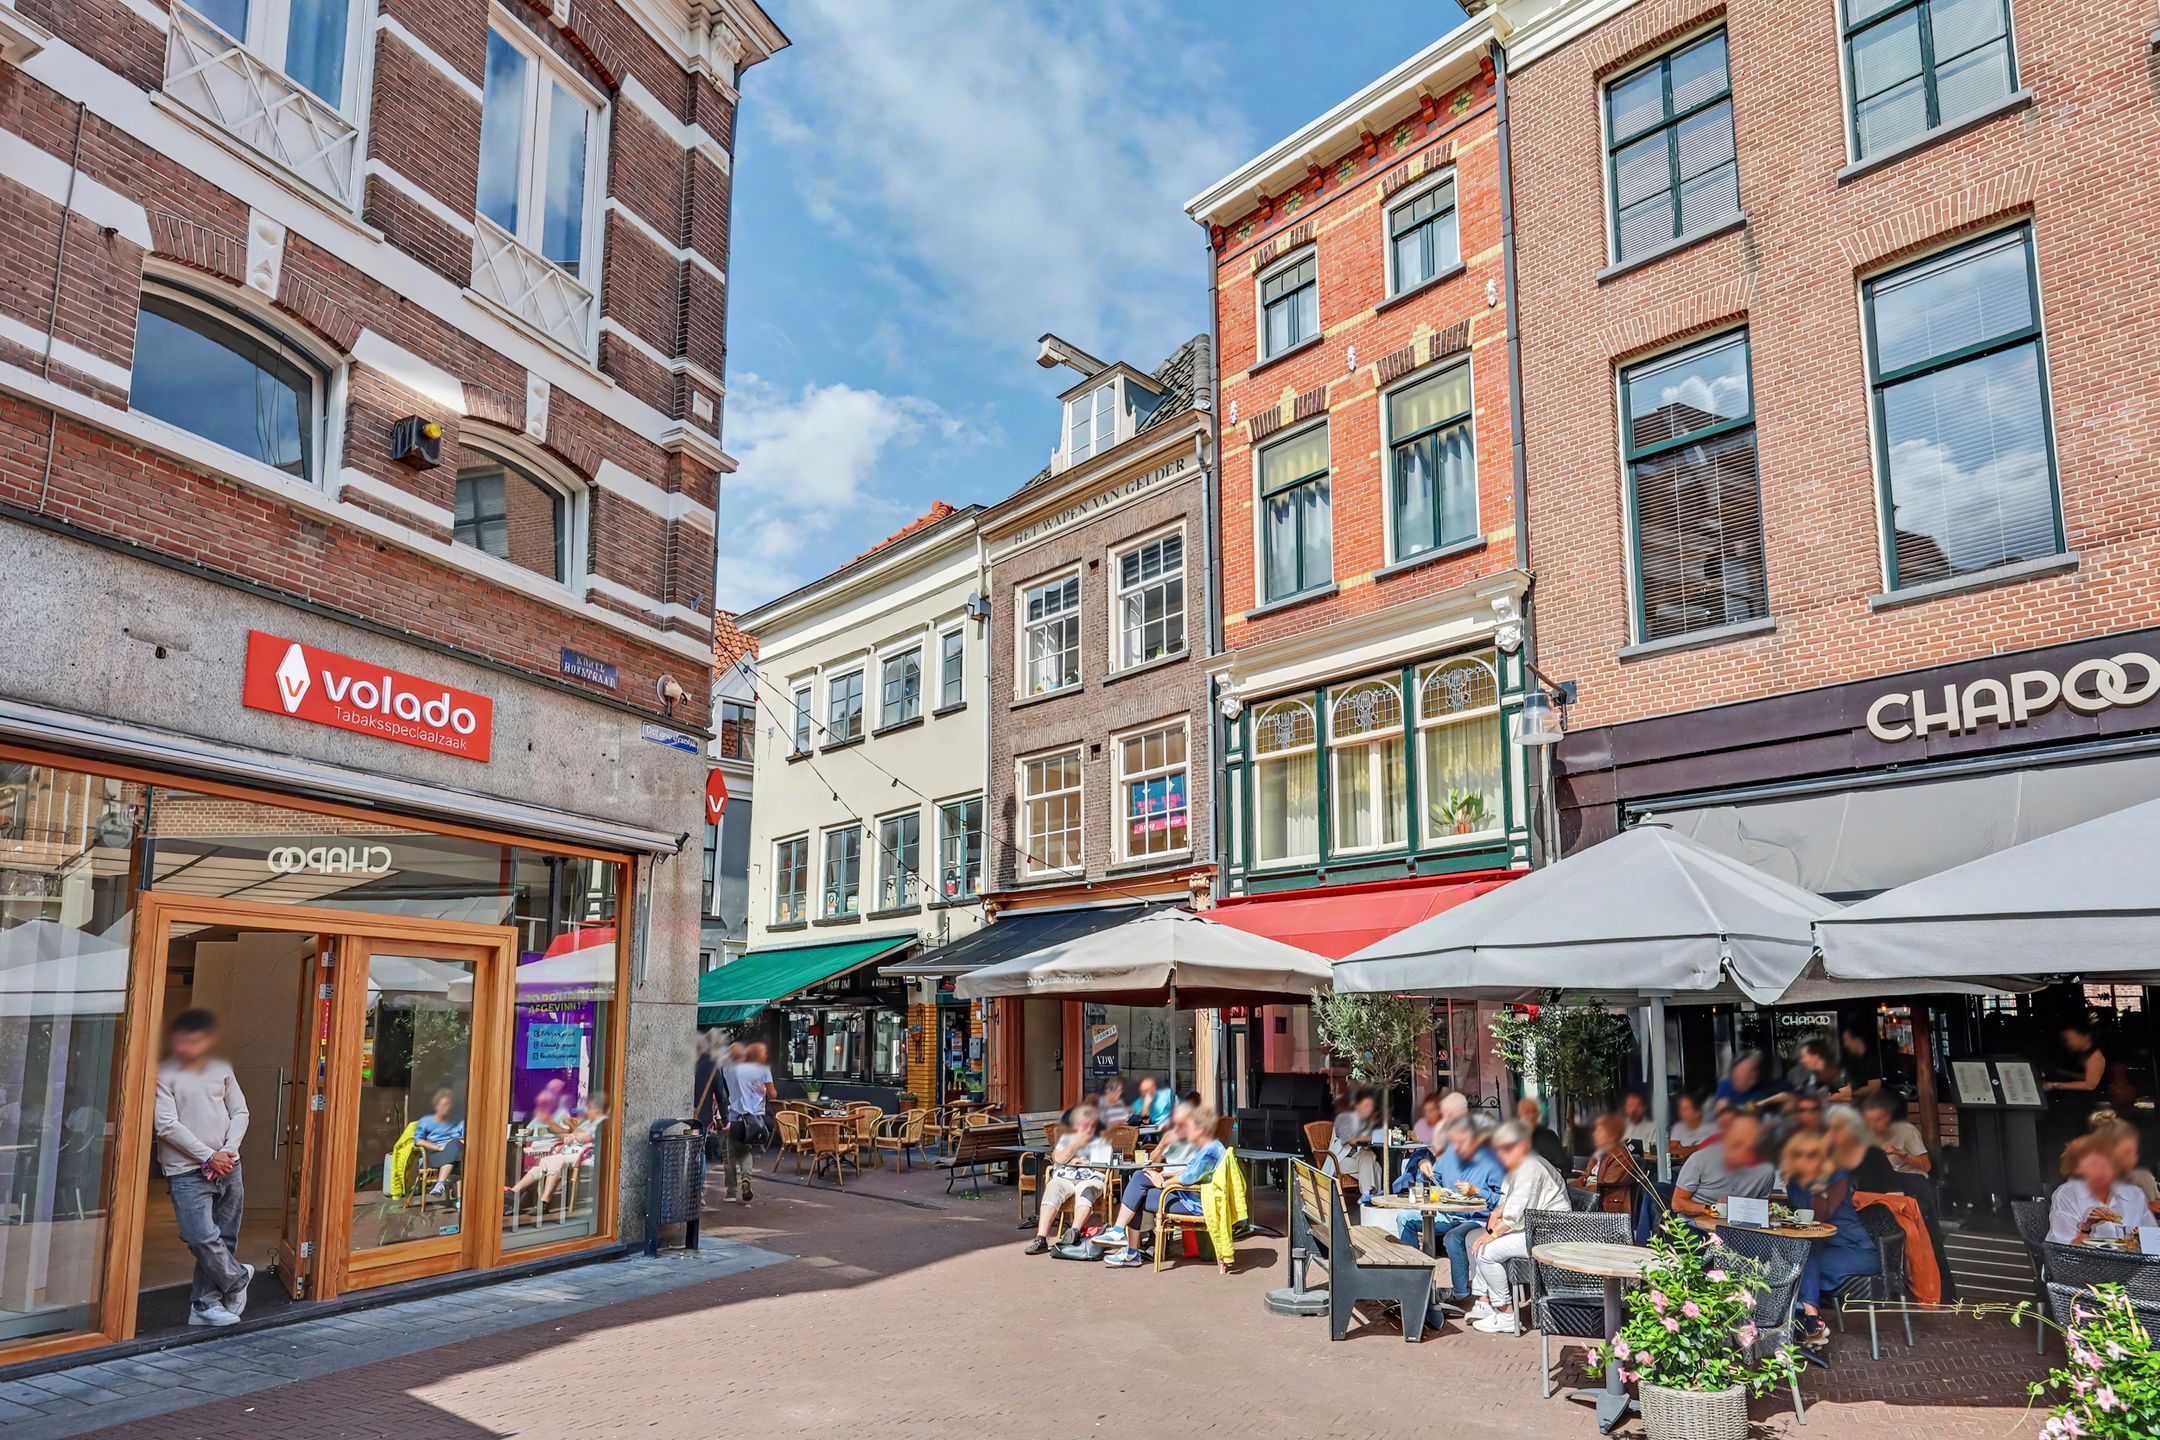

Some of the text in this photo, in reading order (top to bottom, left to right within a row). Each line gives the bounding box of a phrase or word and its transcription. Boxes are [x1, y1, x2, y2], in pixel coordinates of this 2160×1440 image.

[1014, 457, 1186, 545] HET WAPEN VAN GELDER
[321, 670, 476, 735] volado
[334, 705, 467, 751] Tabaksspeciaalzaak
[1866, 652, 2160, 741] CHAPOO
